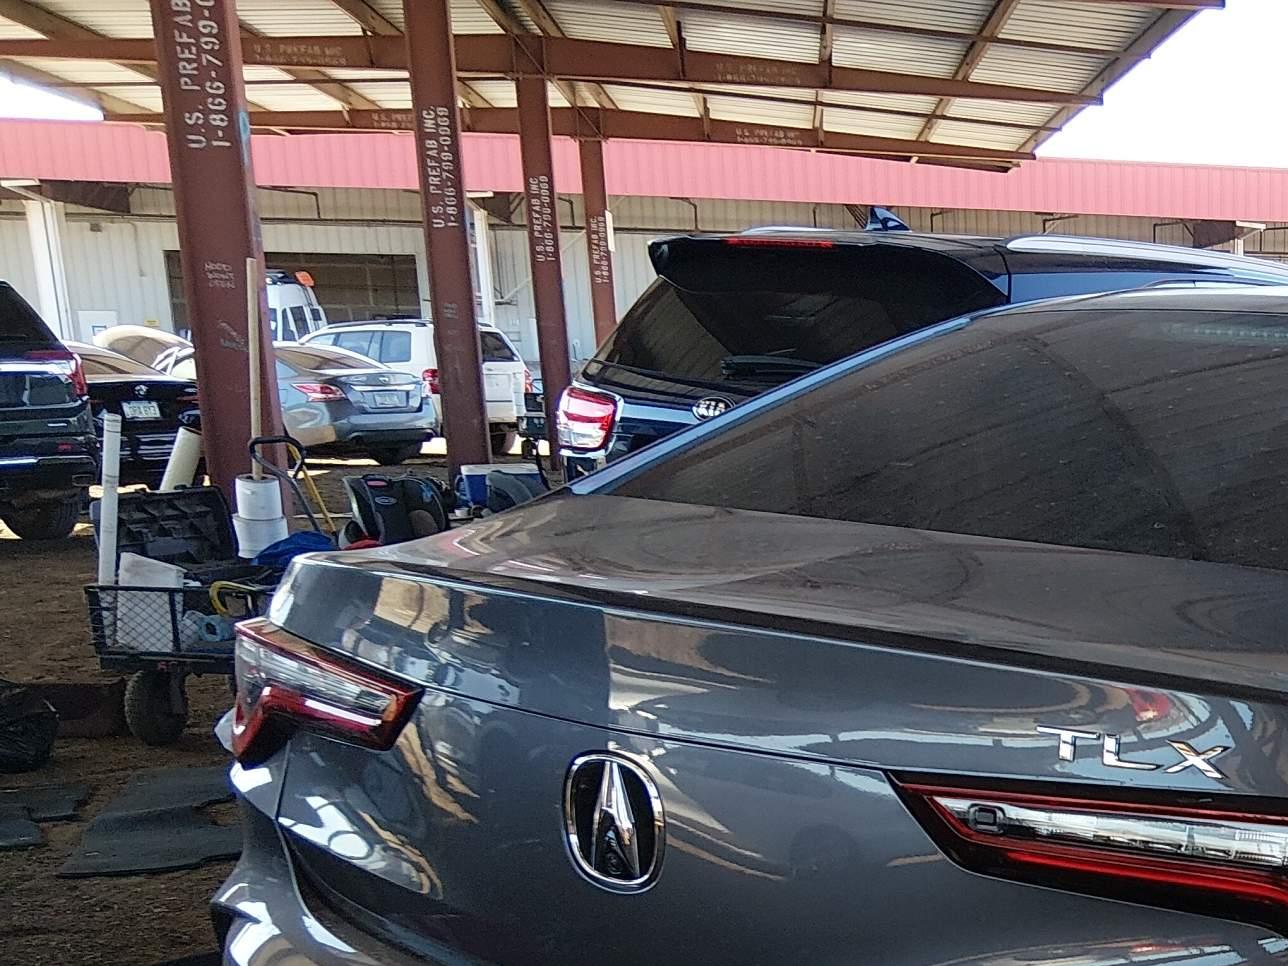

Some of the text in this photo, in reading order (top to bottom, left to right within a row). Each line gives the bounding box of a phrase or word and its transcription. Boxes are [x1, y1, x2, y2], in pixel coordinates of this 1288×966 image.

[171, 0, 207, 148] U.S. PREFAB
[425, 139, 442, 194] PREFAB
[431, 200, 445, 228] U.S.
[531, 198, 544, 238] PREFAB
[696, 399, 727, 417] KIA
[1036, 725, 1231, 779] TLX
